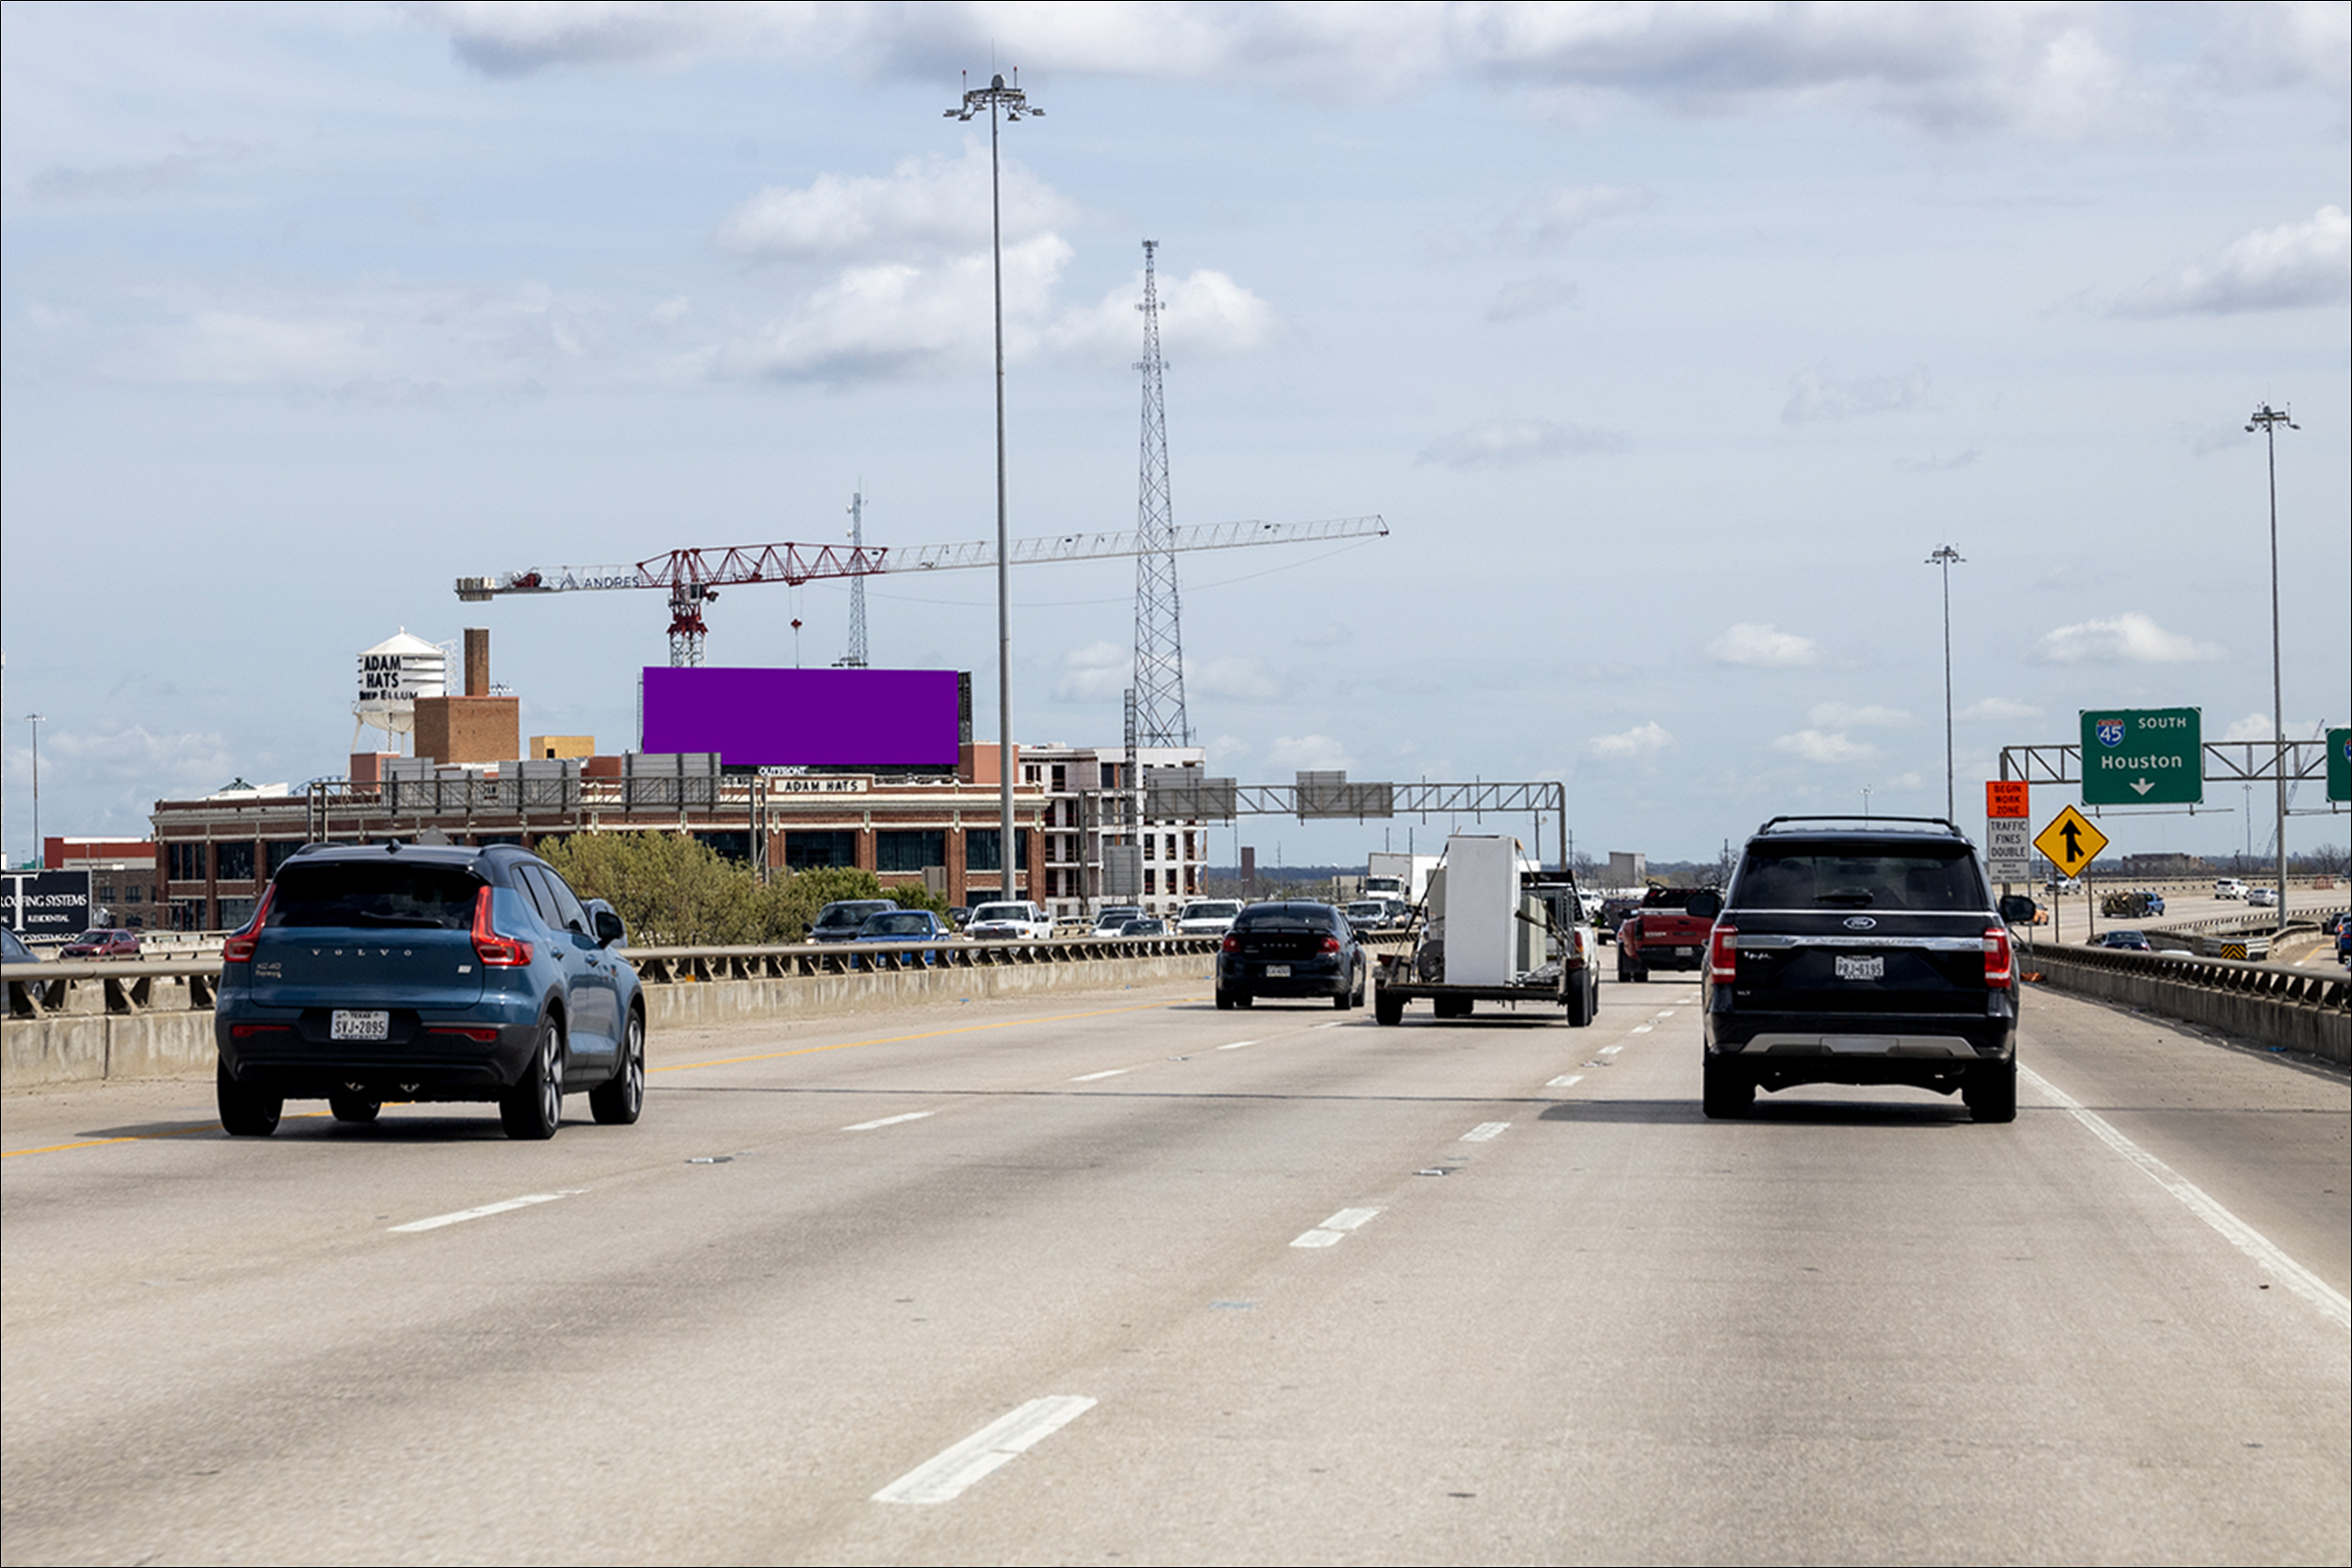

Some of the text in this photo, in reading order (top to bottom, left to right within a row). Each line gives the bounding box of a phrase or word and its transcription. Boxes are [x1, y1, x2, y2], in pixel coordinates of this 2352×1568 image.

[584, 576, 640, 588] ANDRES
[365, 656, 402, 670] ADAM
[367, 672, 399, 688] HATS
[380, 689, 418, 700] ELLUM
[2137, 717, 2186, 729] SOUTH
[2099, 726, 2122, 742] 45
[2101, 755, 2182, 769] Houston
[785, 780, 858, 791] ADAM HATS
[1993, 785, 2021, 794] BEGIN
[1996, 806, 2020, 814] ZONE
[1990, 821, 2026, 831] TRAFFIC
[1995, 834, 2021, 844] FINES
[1990, 847, 2026, 858] DOUBLE
[45, 894, 87, 907] SYSTEMS
